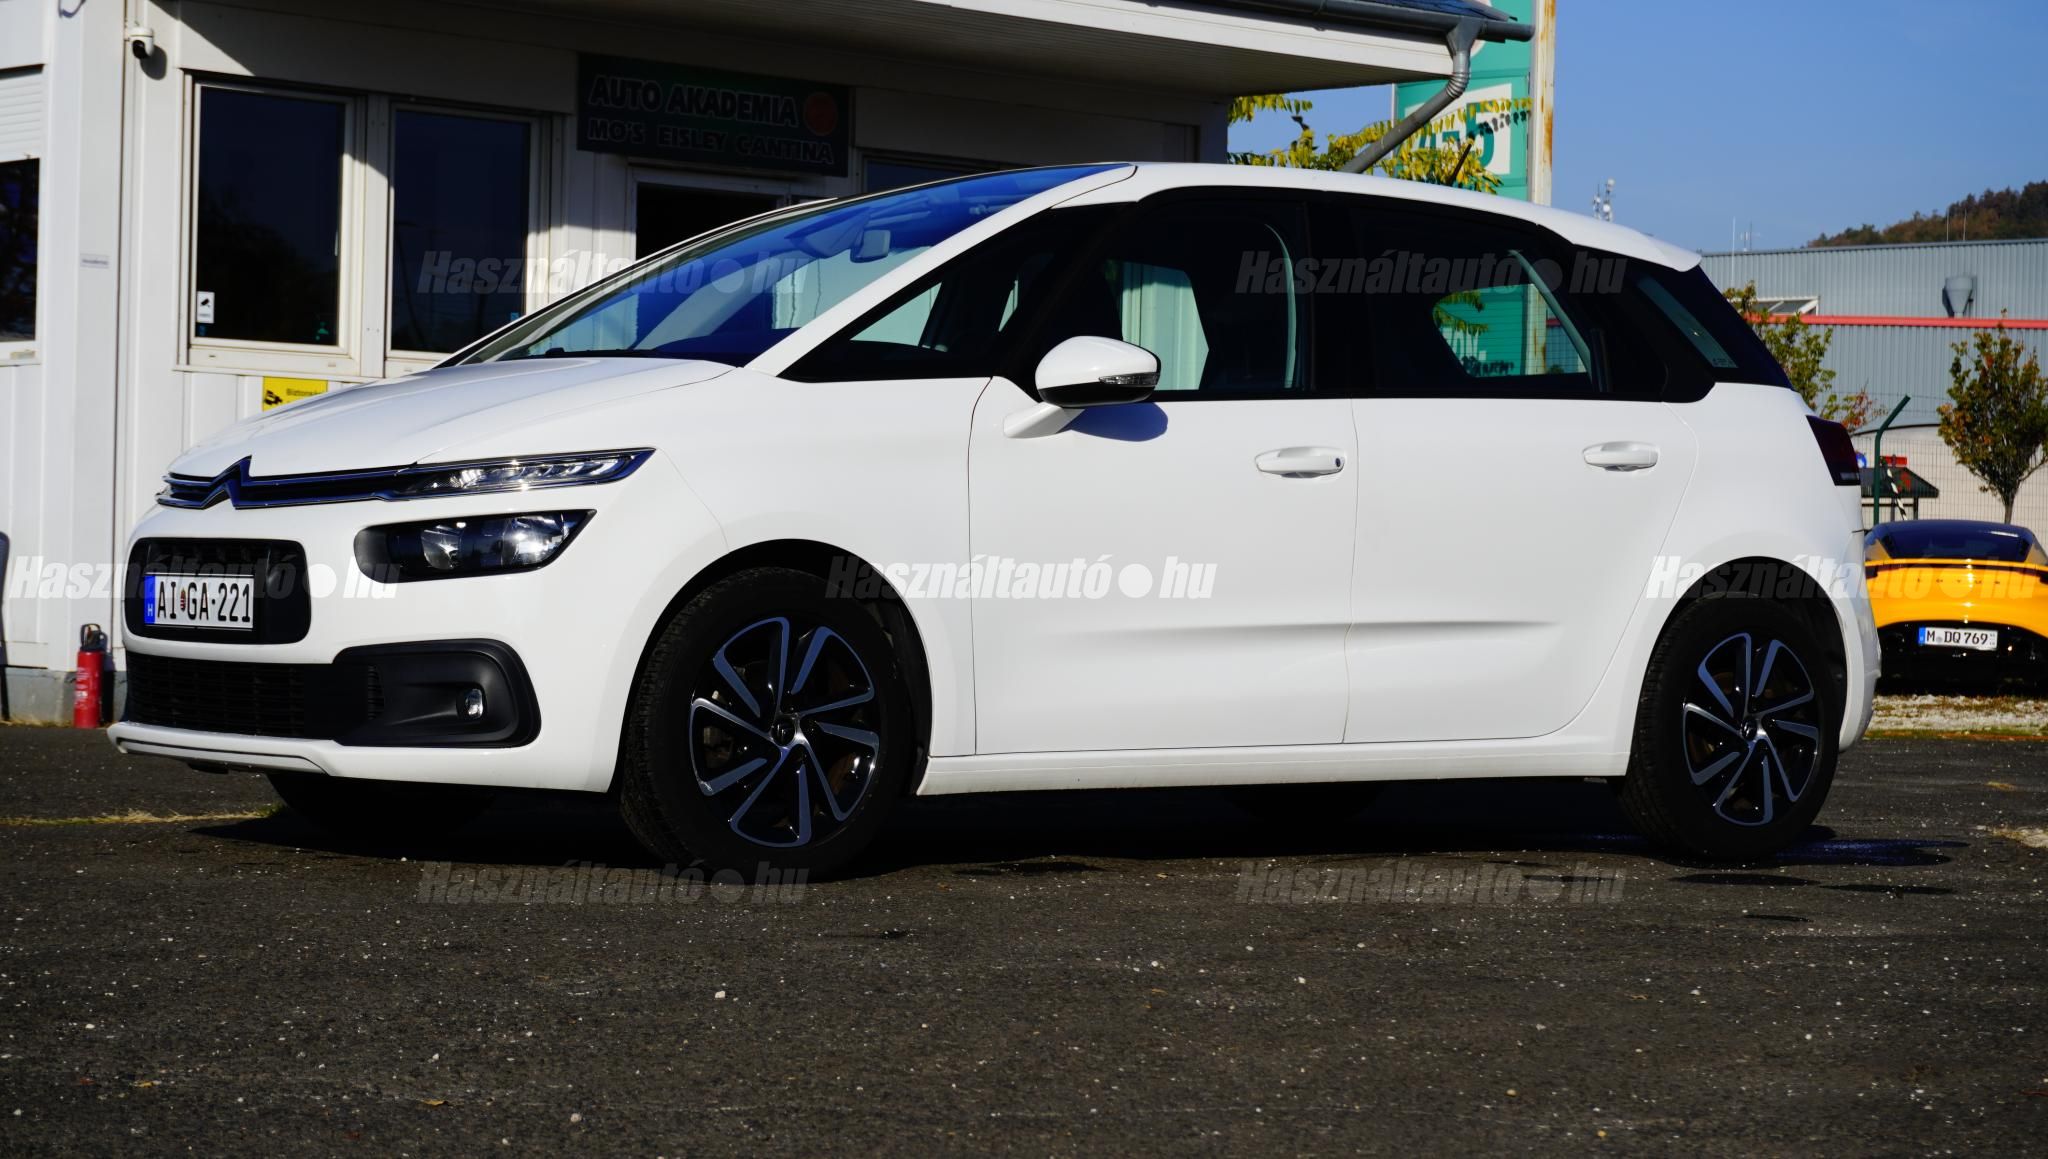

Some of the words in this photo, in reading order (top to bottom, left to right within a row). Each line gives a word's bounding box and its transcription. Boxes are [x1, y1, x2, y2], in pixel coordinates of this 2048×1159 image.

[588, 74, 663, 112] AUTO
[666, 84, 799, 127] AKADEMIA
[587, 118, 647, 144] MO'S
[657, 125, 727, 152] EISLEY
[736, 136, 835, 164] CANTINA
[1964, 632, 1988, 645] 769
